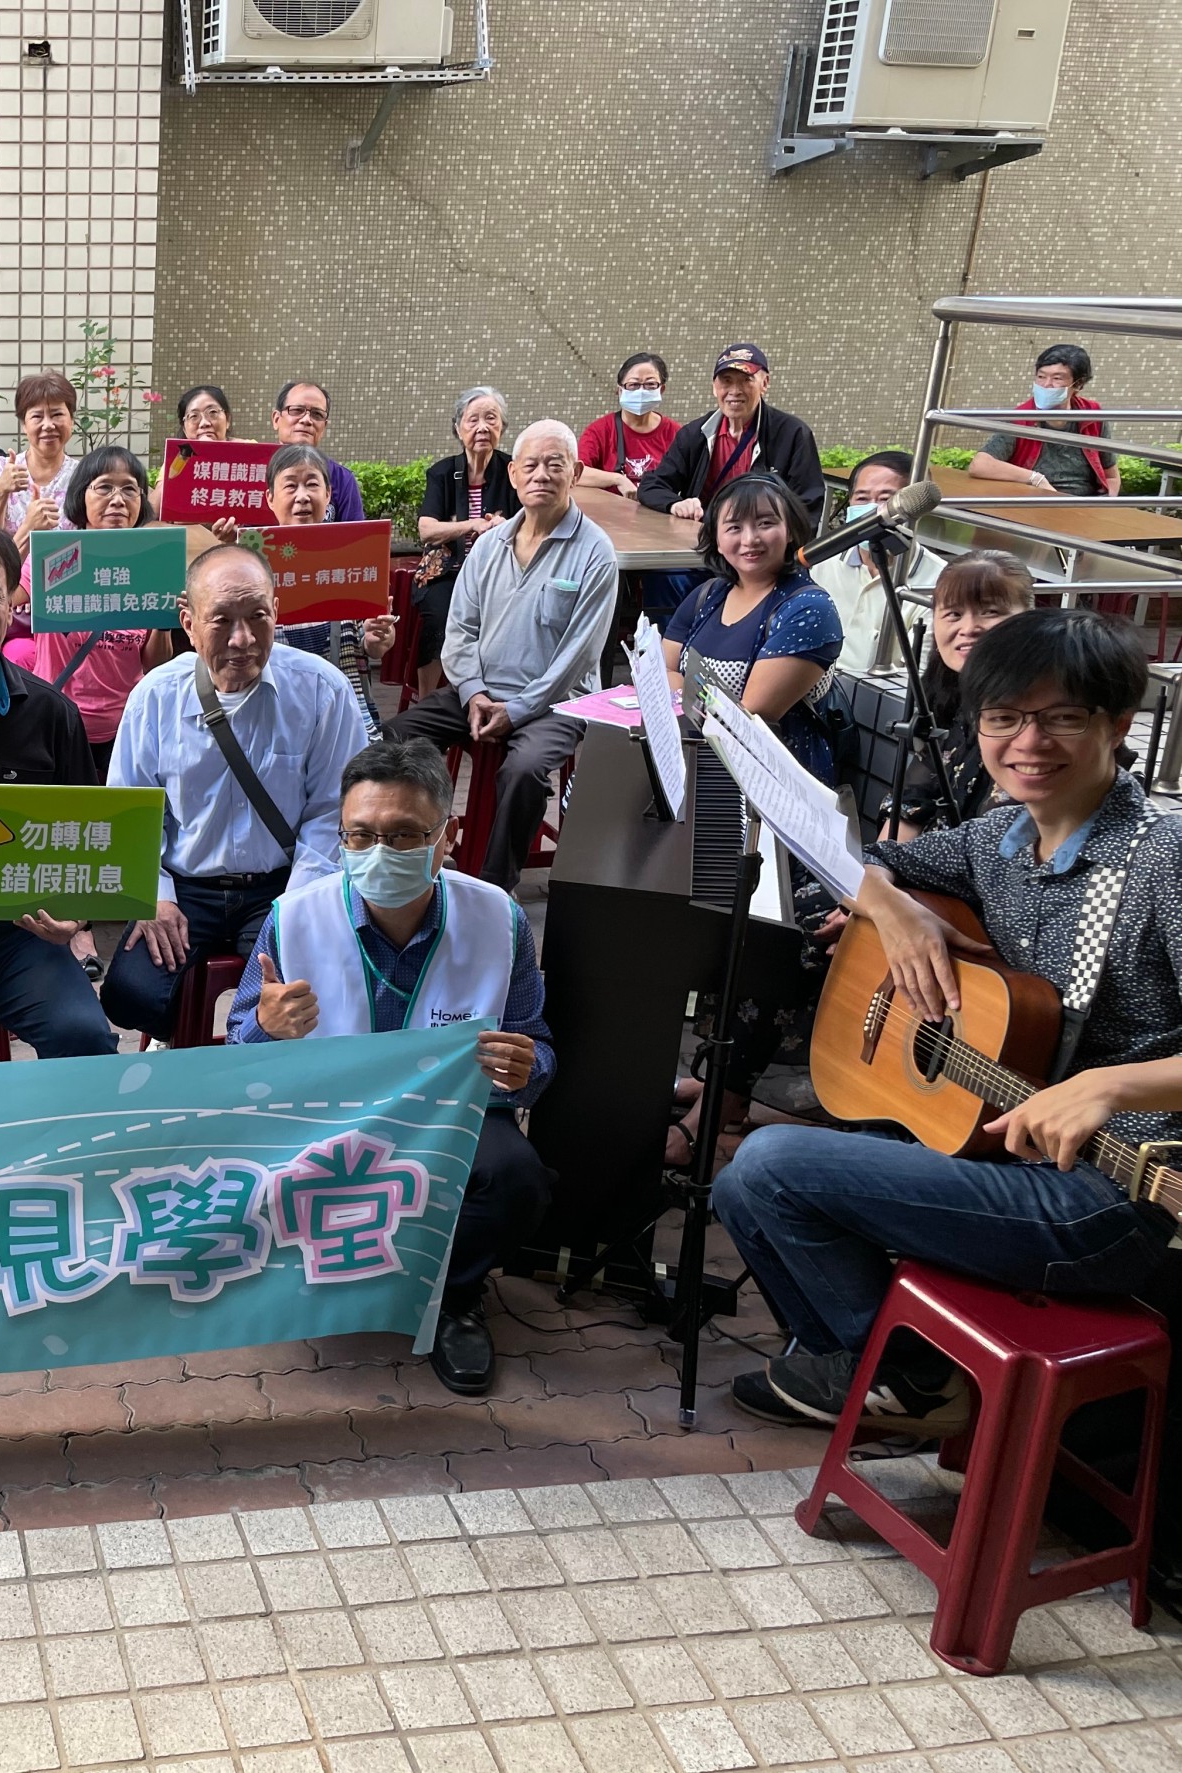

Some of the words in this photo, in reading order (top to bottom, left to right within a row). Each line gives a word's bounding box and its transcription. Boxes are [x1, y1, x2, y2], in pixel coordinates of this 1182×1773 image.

[193, 461, 267, 483] 媒體識讀
[191, 489, 265, 509] 終身教育
[93, 567, 130, 587] 增強
[315, 566, 378, 585] 病毒行銷
[45, 591, 178, 614] 媒體識讀免疫力
[19, 820, 113, 852] 勿轉傳
[0, 863, 124, 894] 錯假訊息
